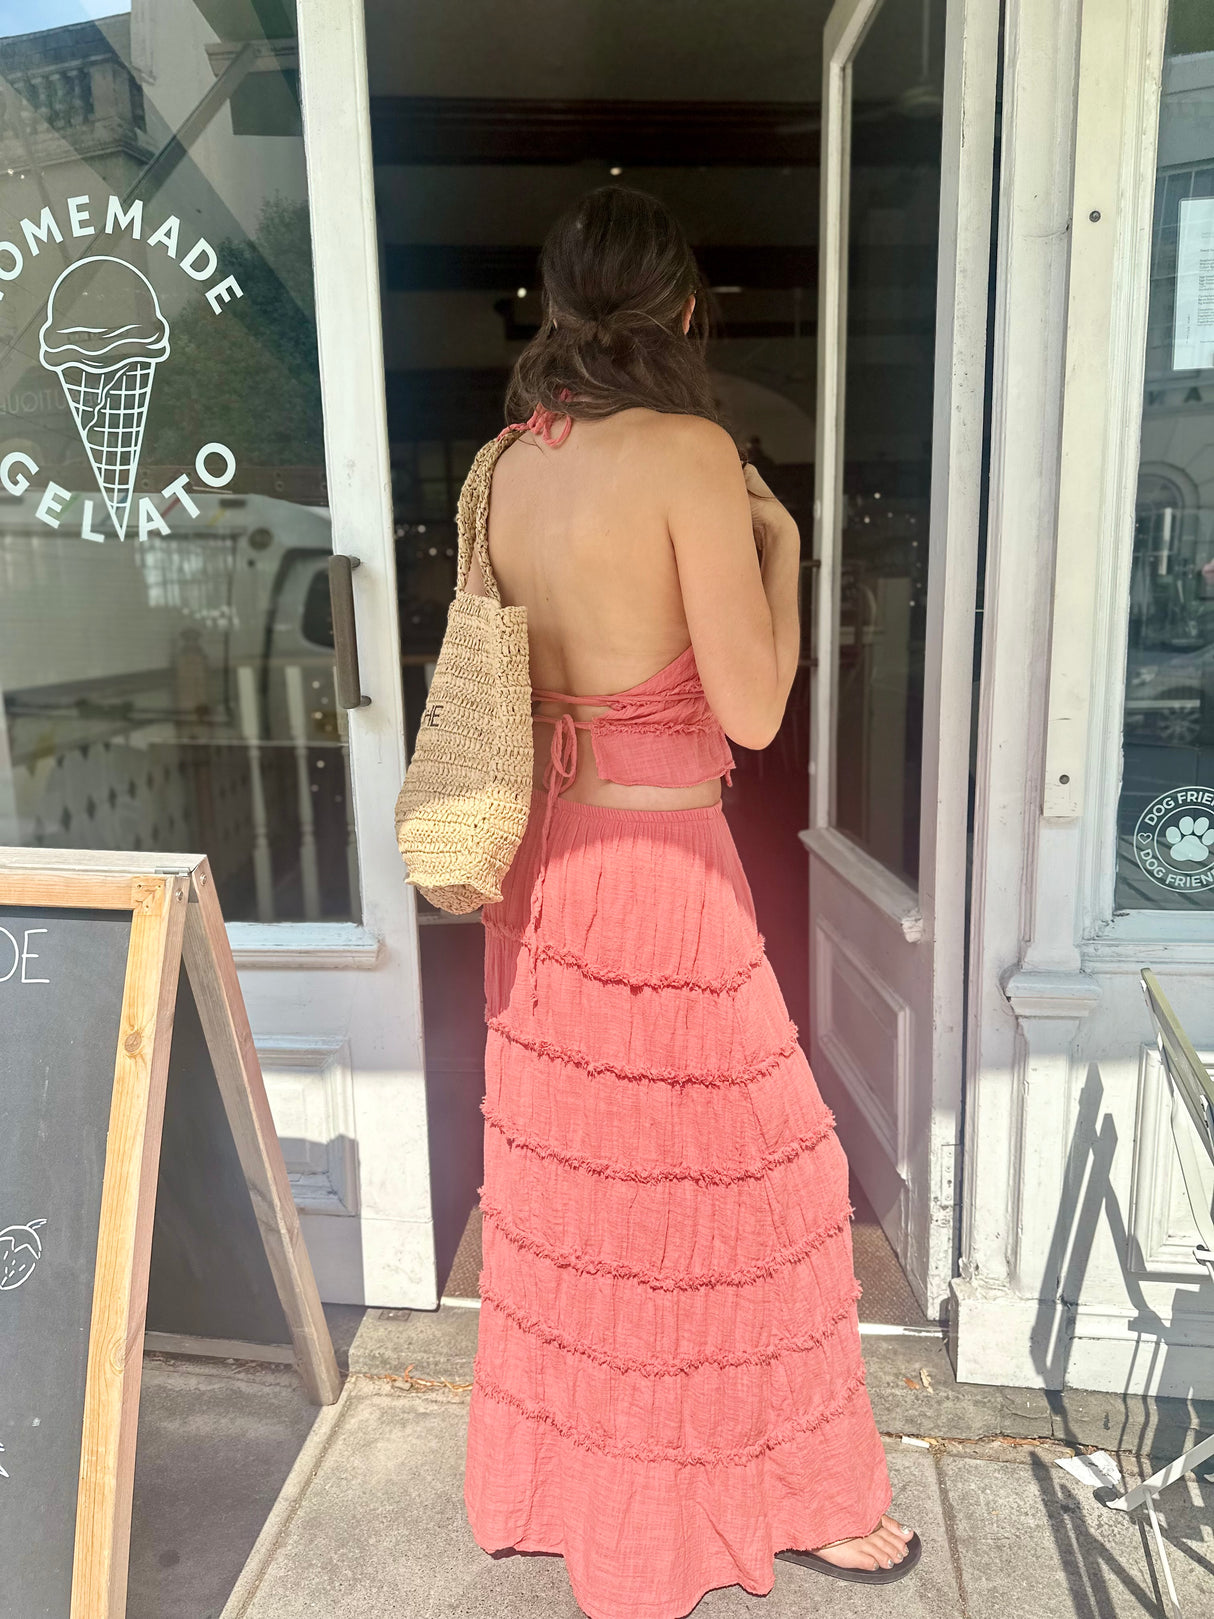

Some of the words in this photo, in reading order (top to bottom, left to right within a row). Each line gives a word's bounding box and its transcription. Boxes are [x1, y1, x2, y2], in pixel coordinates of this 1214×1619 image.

[0, 195, 244, 315] OMEMADE
[0, 442, 236, 543] GELATO
[1144, 797, 1175, 826] DOG
[1140, 849, 1166, 878] DOG
